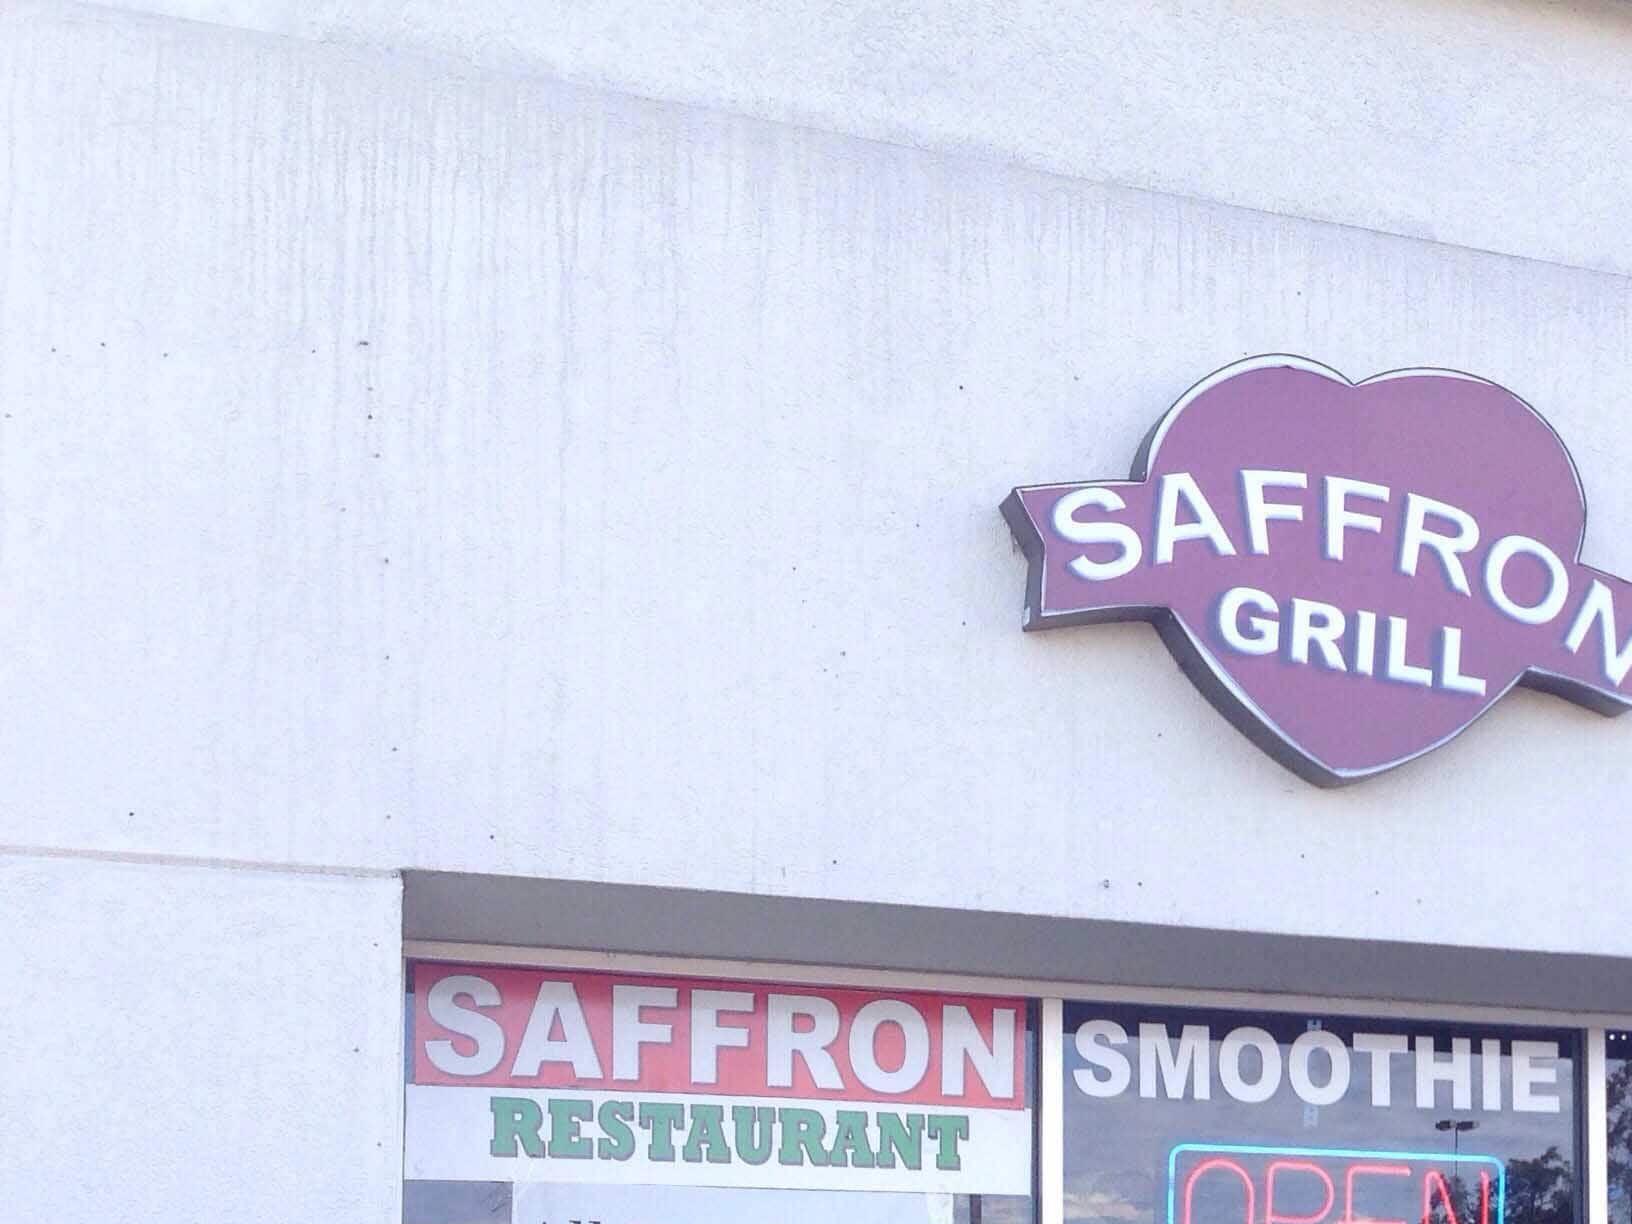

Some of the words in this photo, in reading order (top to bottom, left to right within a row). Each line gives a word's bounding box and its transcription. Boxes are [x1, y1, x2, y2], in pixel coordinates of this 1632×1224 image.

[1216, 586, 1487, 697] GRILL
[424, 975, 1018, 1099] SAFFRON
[1072, 1018, 1561, 1113] SMOOTHIE
[489, 1096, 969, 1171] RESTAURANT
